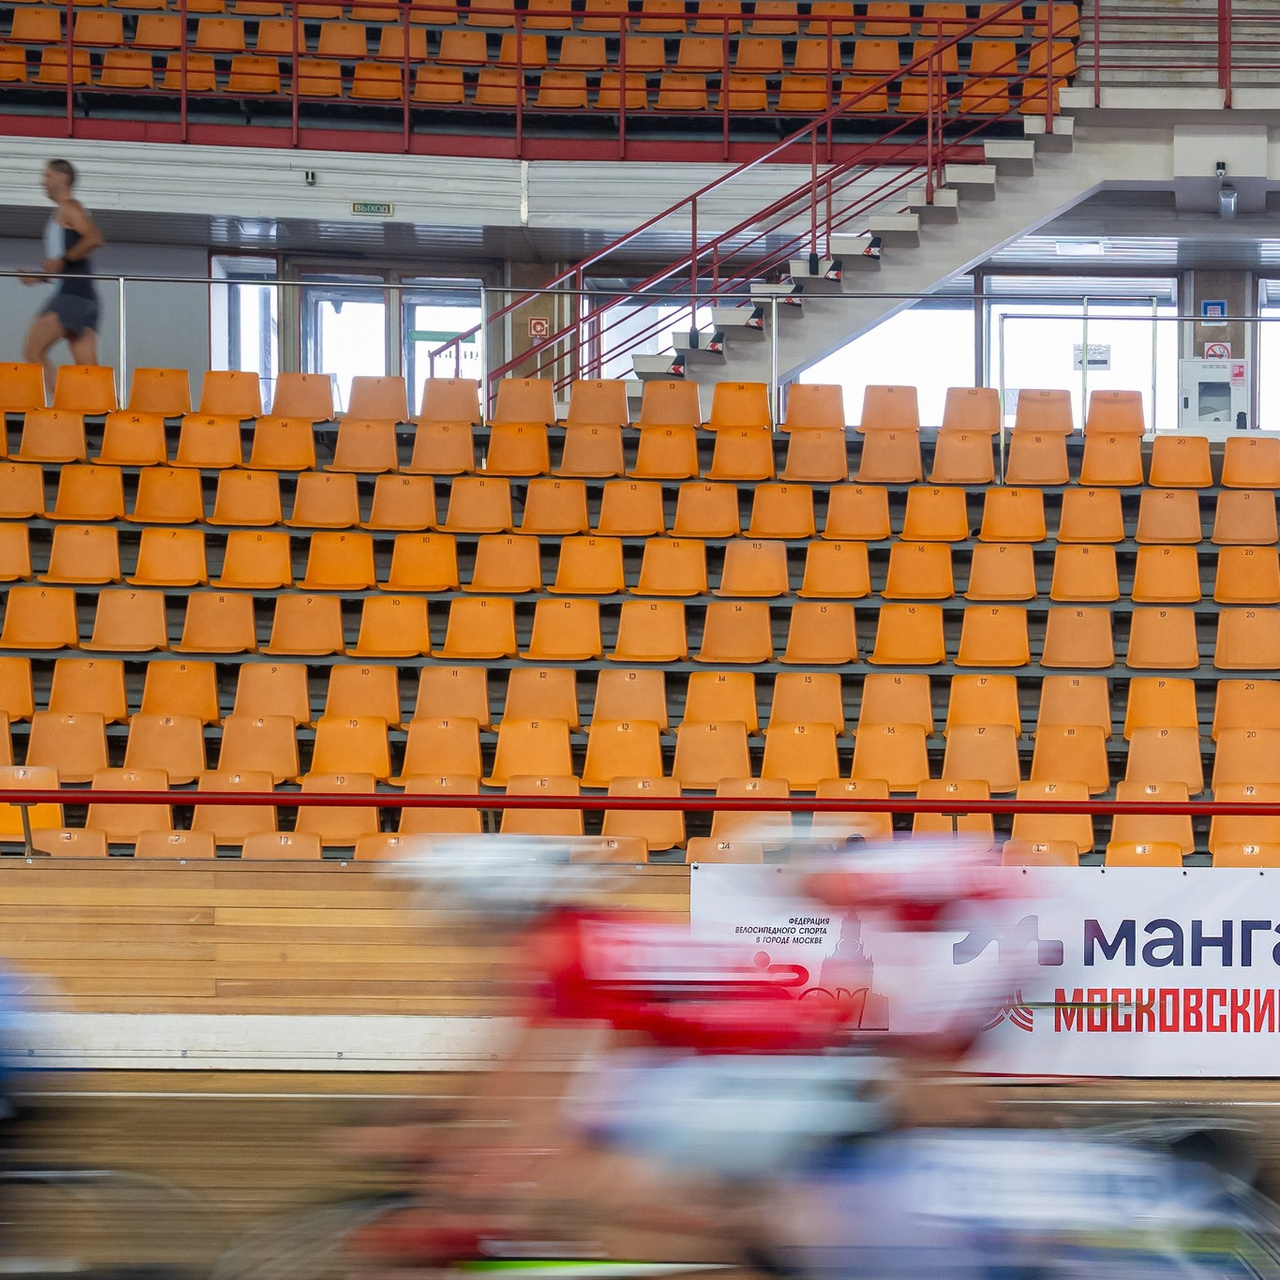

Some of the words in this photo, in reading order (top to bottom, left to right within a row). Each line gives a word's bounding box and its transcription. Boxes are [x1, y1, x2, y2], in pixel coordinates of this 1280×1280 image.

[353, 203, 390, 214] ВЫХОД
[788, 917, 830, 925] ФЕДЕРАЦИЯ
[735, 926, 797, 935] ВЕЛОСИПЕДНОГО
[798, 927, 828, 935] СПОРТА
[755, 936, 761, 944] В
[762, 936, 790, 945] ГОРОДЕ
[792, 936, 823, 944] МОСКВЕ
